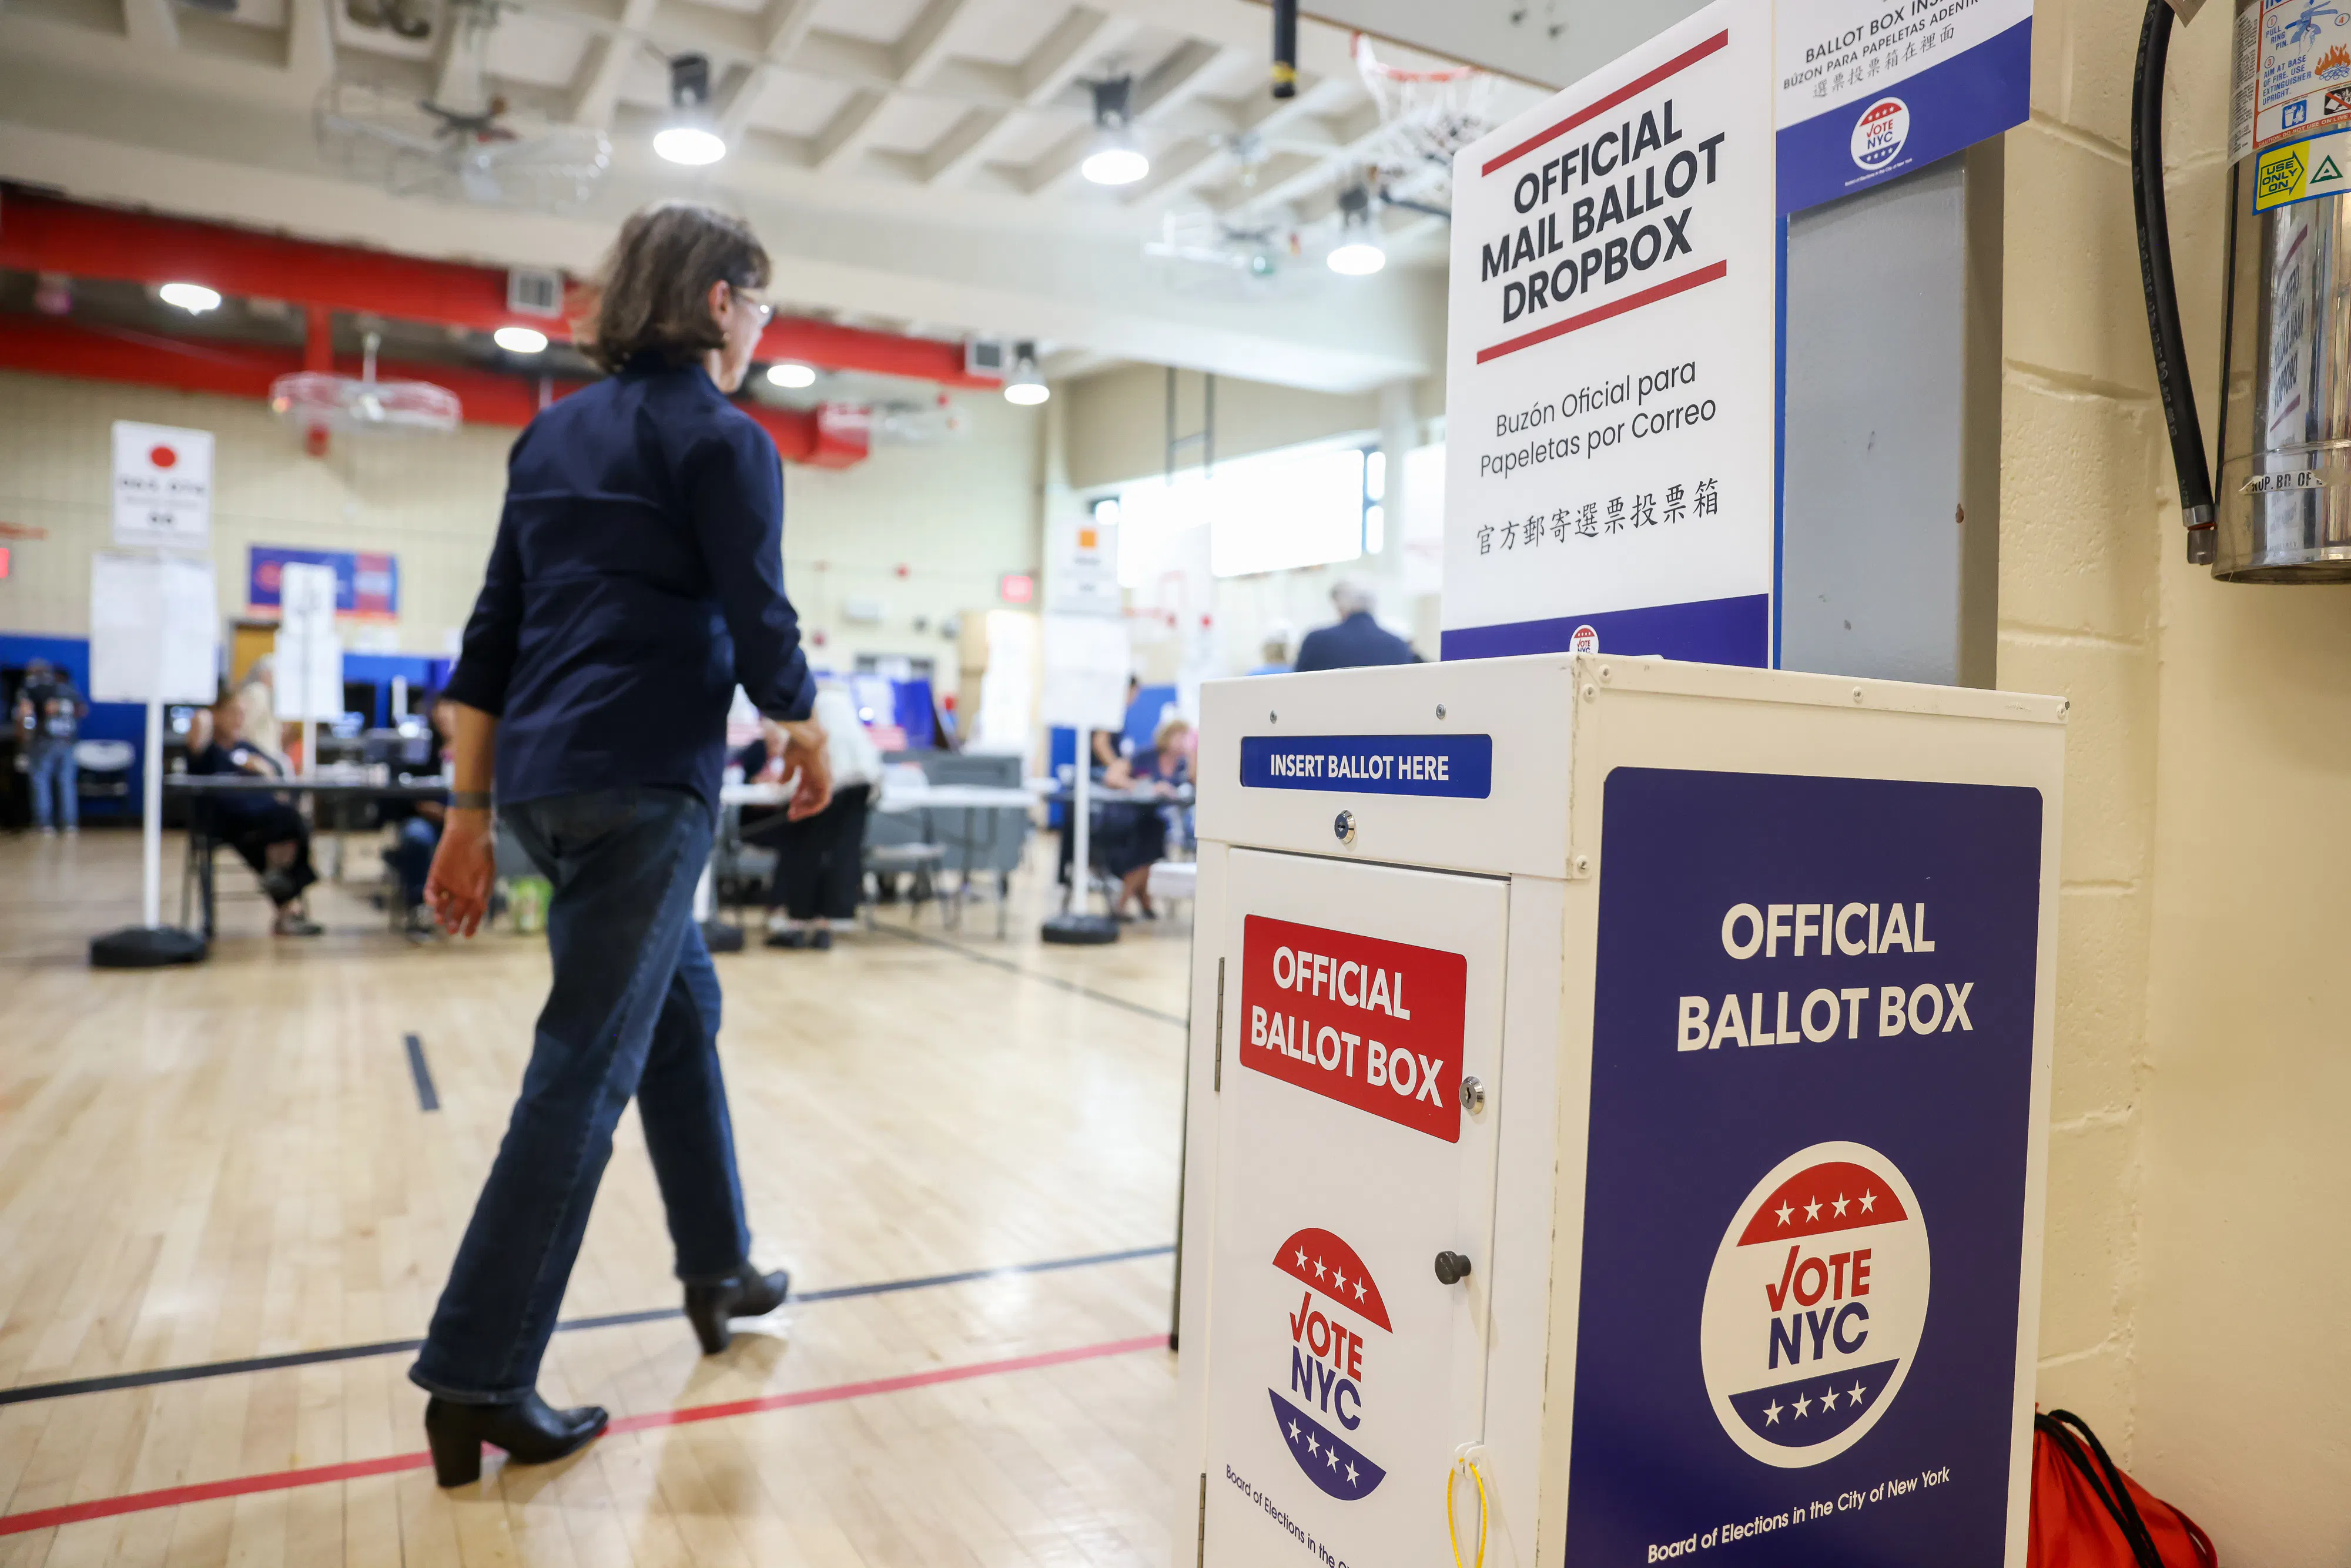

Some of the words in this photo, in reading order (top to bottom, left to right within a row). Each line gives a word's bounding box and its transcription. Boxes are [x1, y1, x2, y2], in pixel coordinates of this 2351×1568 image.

[1806, 26, 1864, 63] BALLOT
[1870, 6, 1905, 36] BOX
[1827, 51, 1858, 73] PARA
[1862, 19, 1925, 57] PAPELETAS
[2266, 25, 2282, 38] PULL
[2270, 31, 2286, 44] RING
[2263, 78, 2271, 88] OF
[2273, 71, 2289, 83] FIRE.
[2291, 64, 2305, 75] USE
[2263, 71, 2312, 97] EXTINGUISHER
[2264, 67, 2275, 79] AIM
[2276, 62, 2286, 73] AT
[2288, 55, 2306, 68] BASE
[2262, 88, 2292, 105] UPRIGHT.
[2306, 121, 2320, 129] USE
[1514, 98, 1683, 214] OFFICIAL
[1867, 131, 1893, 149] NYC
[2266, 160, 2294, 175] USE
[2262, 168, 2298, 186] ONLY
[2268, 180, 2288, 192] ON
[1482, 212, 1563, 282] MAIL
[1572, 132, 1725, 244] BALLOT
[1503, 207, 1693, 324] DROPBOX
[1496, 401, 1555, 437] Buzón
[1562, 375, 1630, 418] Oficial
[1638, 361, 1696, 406] para
[1481, 434, 1580, 479] Papeletas
[1588, 423, 1625, 459] por
[1632, 398, 1716, 438] Correo
[2298, 472, 2312, 487] OF
[1476, 477, 1719, 556] 官方郵寄選票投票箱
[1270, 754, 1325, 778] INSERT
[1328, 755, 1394, 780] BALLOT
[1398, 756, 1449, 780] HERE
[1721, 902, 1935, 960] OFFICIAL
[1273, 946, 1411, 1021] OFFICIAL
[1677, 987, 1870, 1052] BALLOT
[1879, 982, 1974, 1037] BOX
[1251, 1004, 1361, 1078] BALLOT
[1367, 1039, 1444, 1108] BOX
[1765, 1245, 1872, 1312] VOTE
[1290, 1291, 1363, 1383] VOTE
[1768, 1302, 1870, 1371] NYC
[1291, 1345, 1362, 1431] NYC
[1227, 1464, 1251, 1497] Board
[1253, 1492, 1262, 1506] of
[1264, 1497, 1305, 1544] Elections
[1308, 1533, 1316, 1554] in
[1319, 1543, 1335, 1568] the
[1647, 1534, 1697, 1564] Board
[1700, 1528, 1719, 1549] of
[1722, 1514, 1789, 1544] Elections
[1793, 1506, 1806, 1525] in
[1810, 1501, 1833, 1520] the
[1837, 1490, 1866, 1510] City
[1870, 1483, 1884, 1502] of
[1887, 1477, 1918, 1498] New
[1922, 1466, 1950, 1489] York
